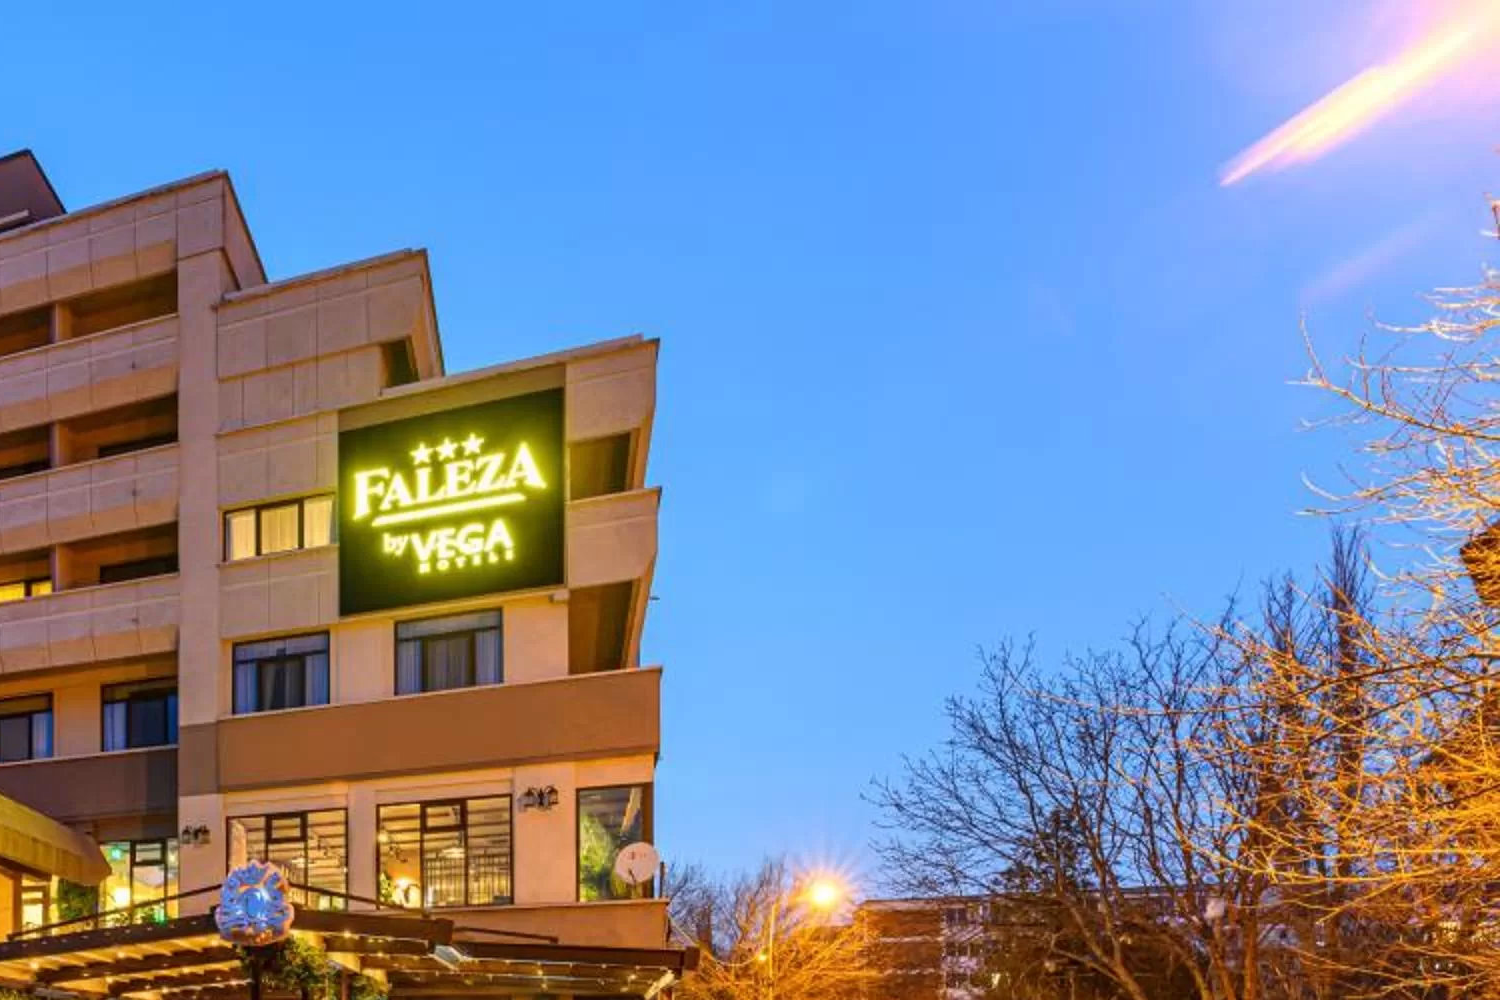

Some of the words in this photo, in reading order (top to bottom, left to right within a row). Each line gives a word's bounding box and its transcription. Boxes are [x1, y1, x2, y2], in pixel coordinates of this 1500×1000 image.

[353, 441, 547, 521] FALEZA
[383, 532, 409, 556] by
[411, 518, 514, 561] VEGA
